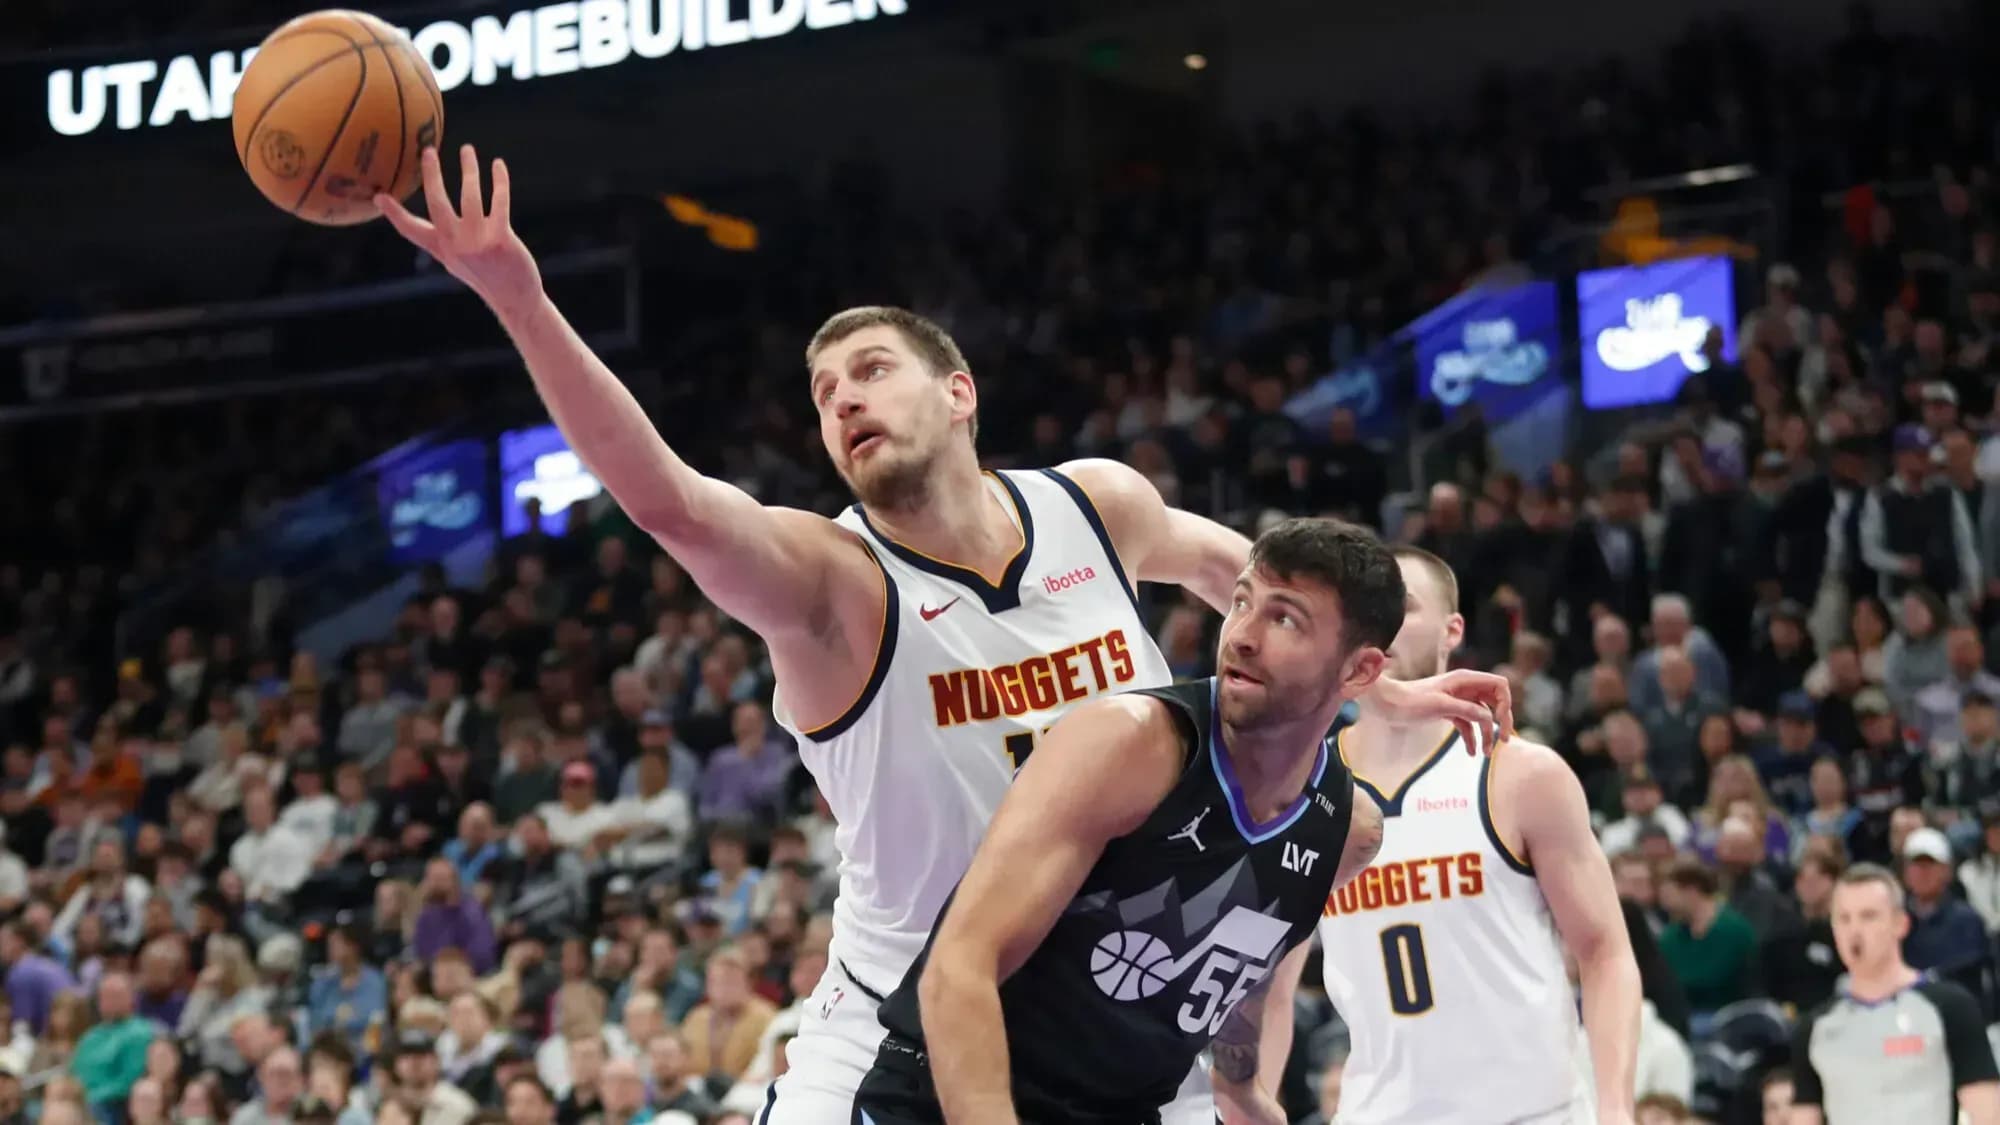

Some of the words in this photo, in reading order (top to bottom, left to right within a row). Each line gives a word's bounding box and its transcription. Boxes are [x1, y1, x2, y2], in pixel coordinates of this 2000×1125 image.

[47, 46, 260, 136] UTAH
[404, 0, 908, 91] OMEBUILD
[1042, 566, 1096, 594] ibotta
[929, 628, 1136, 727] NUGGETS
[1281, 841, 1320, 877] LVT
[1178, 950, 1268, 1036] 55
[1379, 921, 1434, 1017] 0
